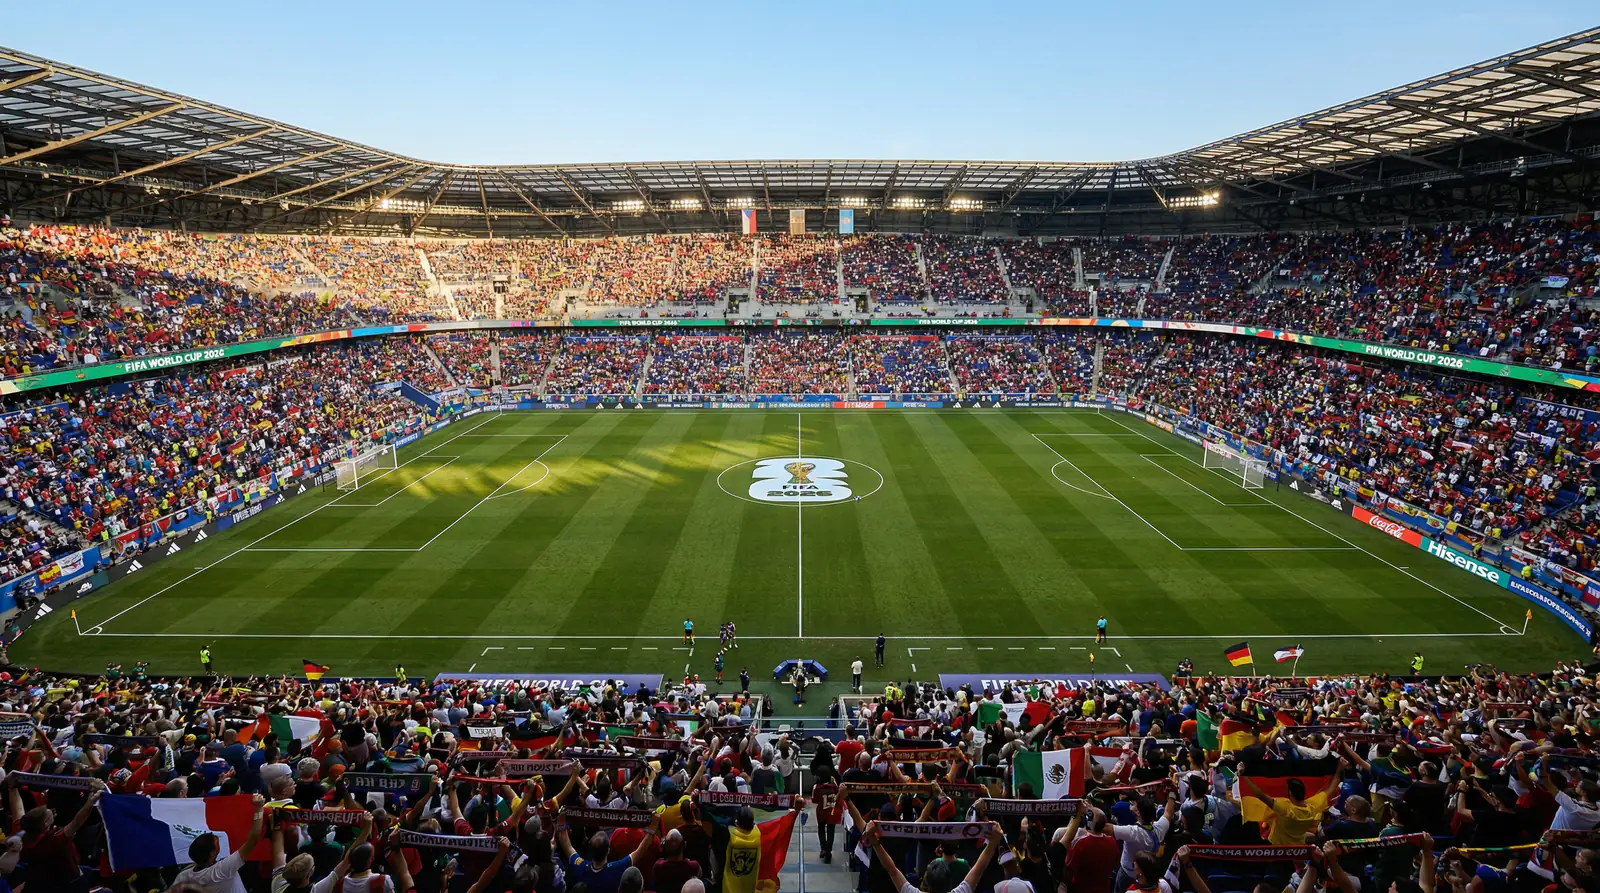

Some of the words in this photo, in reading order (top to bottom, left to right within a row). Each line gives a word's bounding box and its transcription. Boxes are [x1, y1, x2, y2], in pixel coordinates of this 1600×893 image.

[125, 360, 147, 372] FIFA
[148, 355, 183, 367] WORLD
[184, 352, 202, 362] CUP
[1365, 345, 1383, 355] FIFA
[1383, 348, 1415, 360] WORLD
[1416, 353, 1436, 363] CUP
[1437, 356, 1463, 368] 2026
[1427, 540, 1500, 583] Hisense
